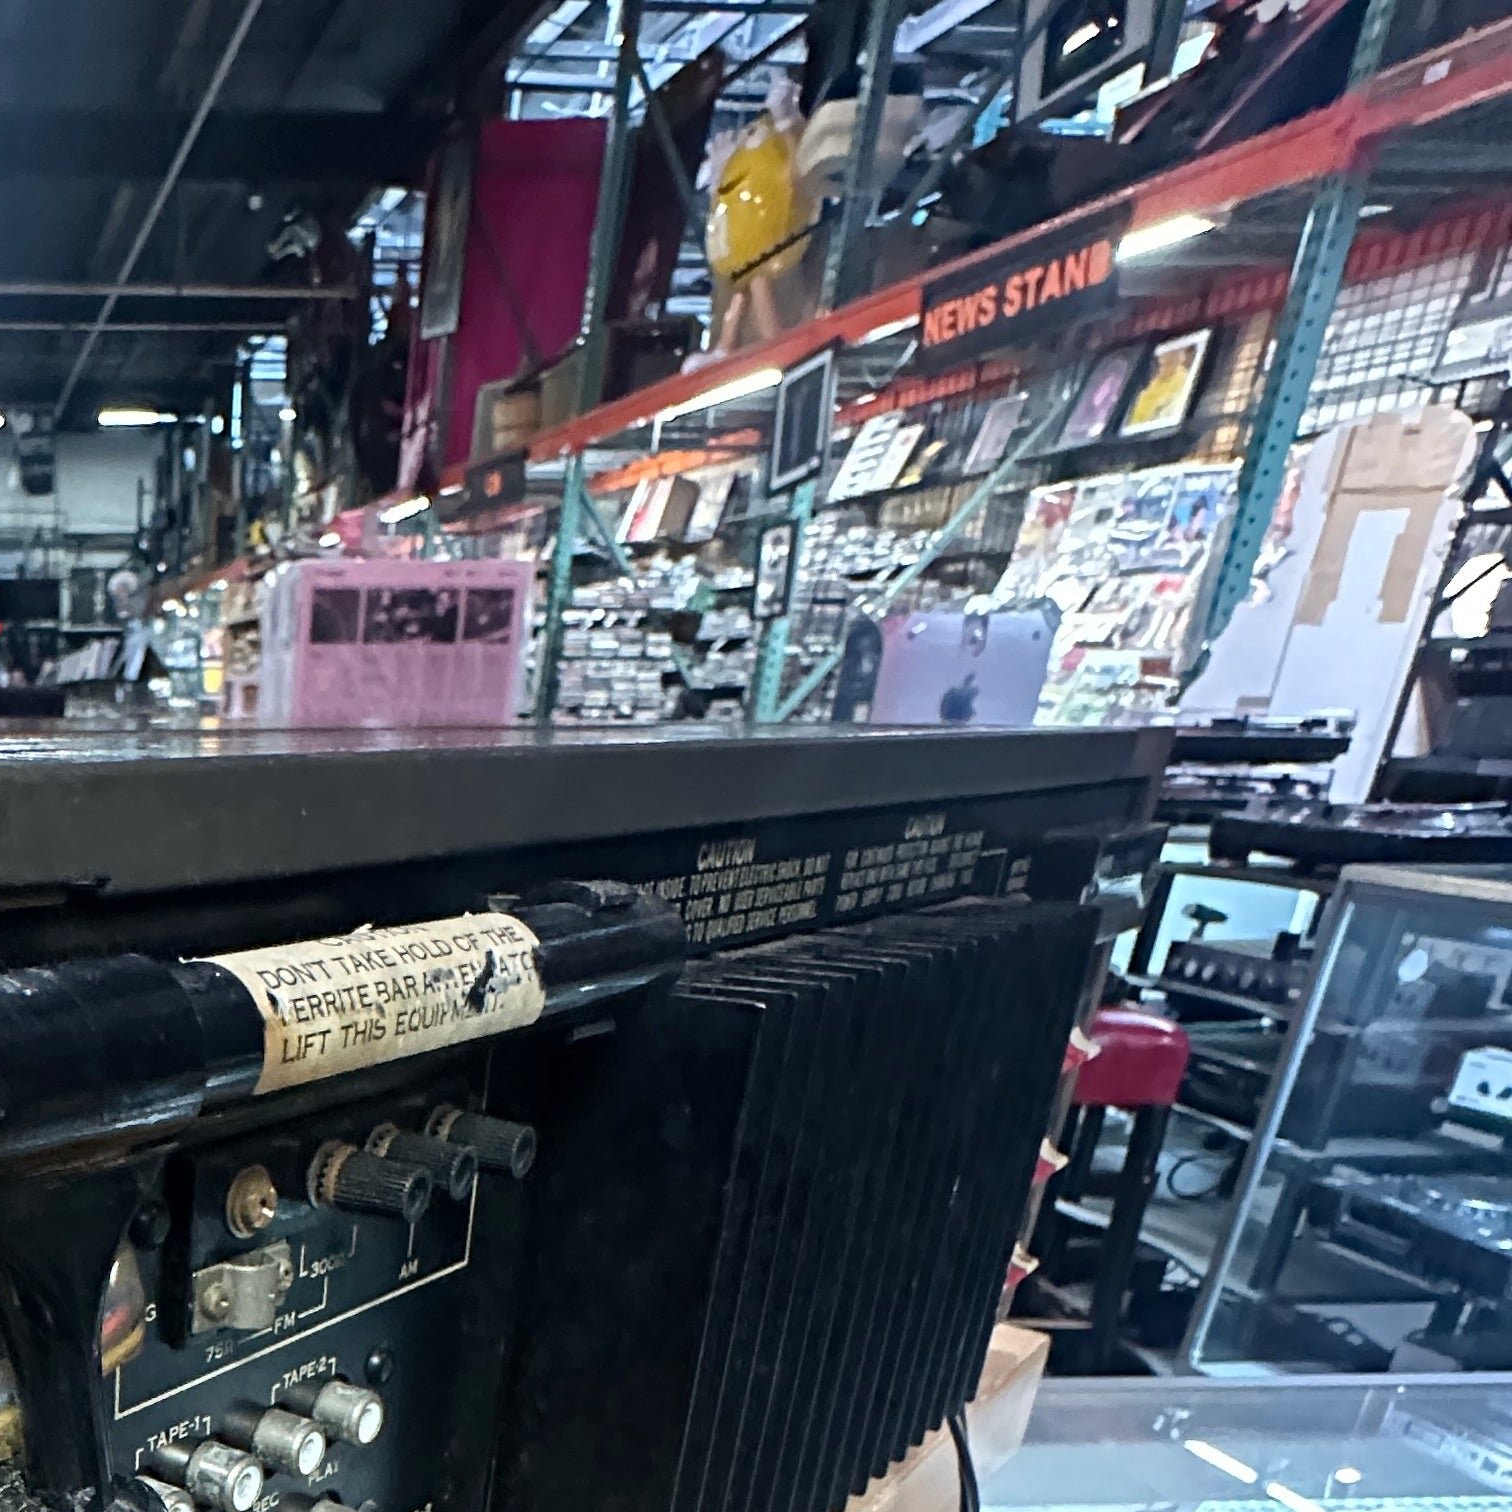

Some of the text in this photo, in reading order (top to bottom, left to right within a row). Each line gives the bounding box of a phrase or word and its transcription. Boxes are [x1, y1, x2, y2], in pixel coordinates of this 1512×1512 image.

[922, 239, 1113, 348] NEWS STAND
[330, 949, 397, 976] TAKE
[391, 939, 453, 964] HOLD
[452, 932, 480, 952] OF
[479, 925, 525, 947] THE
[374, 975, 419, 1004] BAR
[281, 1029, 331, 1065] LIFT
[341, 1017, 387, 1049] THIS
[398, 1258, 419, 1281] AM
[274, 1311, 296, 1335] FM
[283, 1355, 327, 1389] TAPE-2
[147, 1416, 200, 1453] TAPE-1
